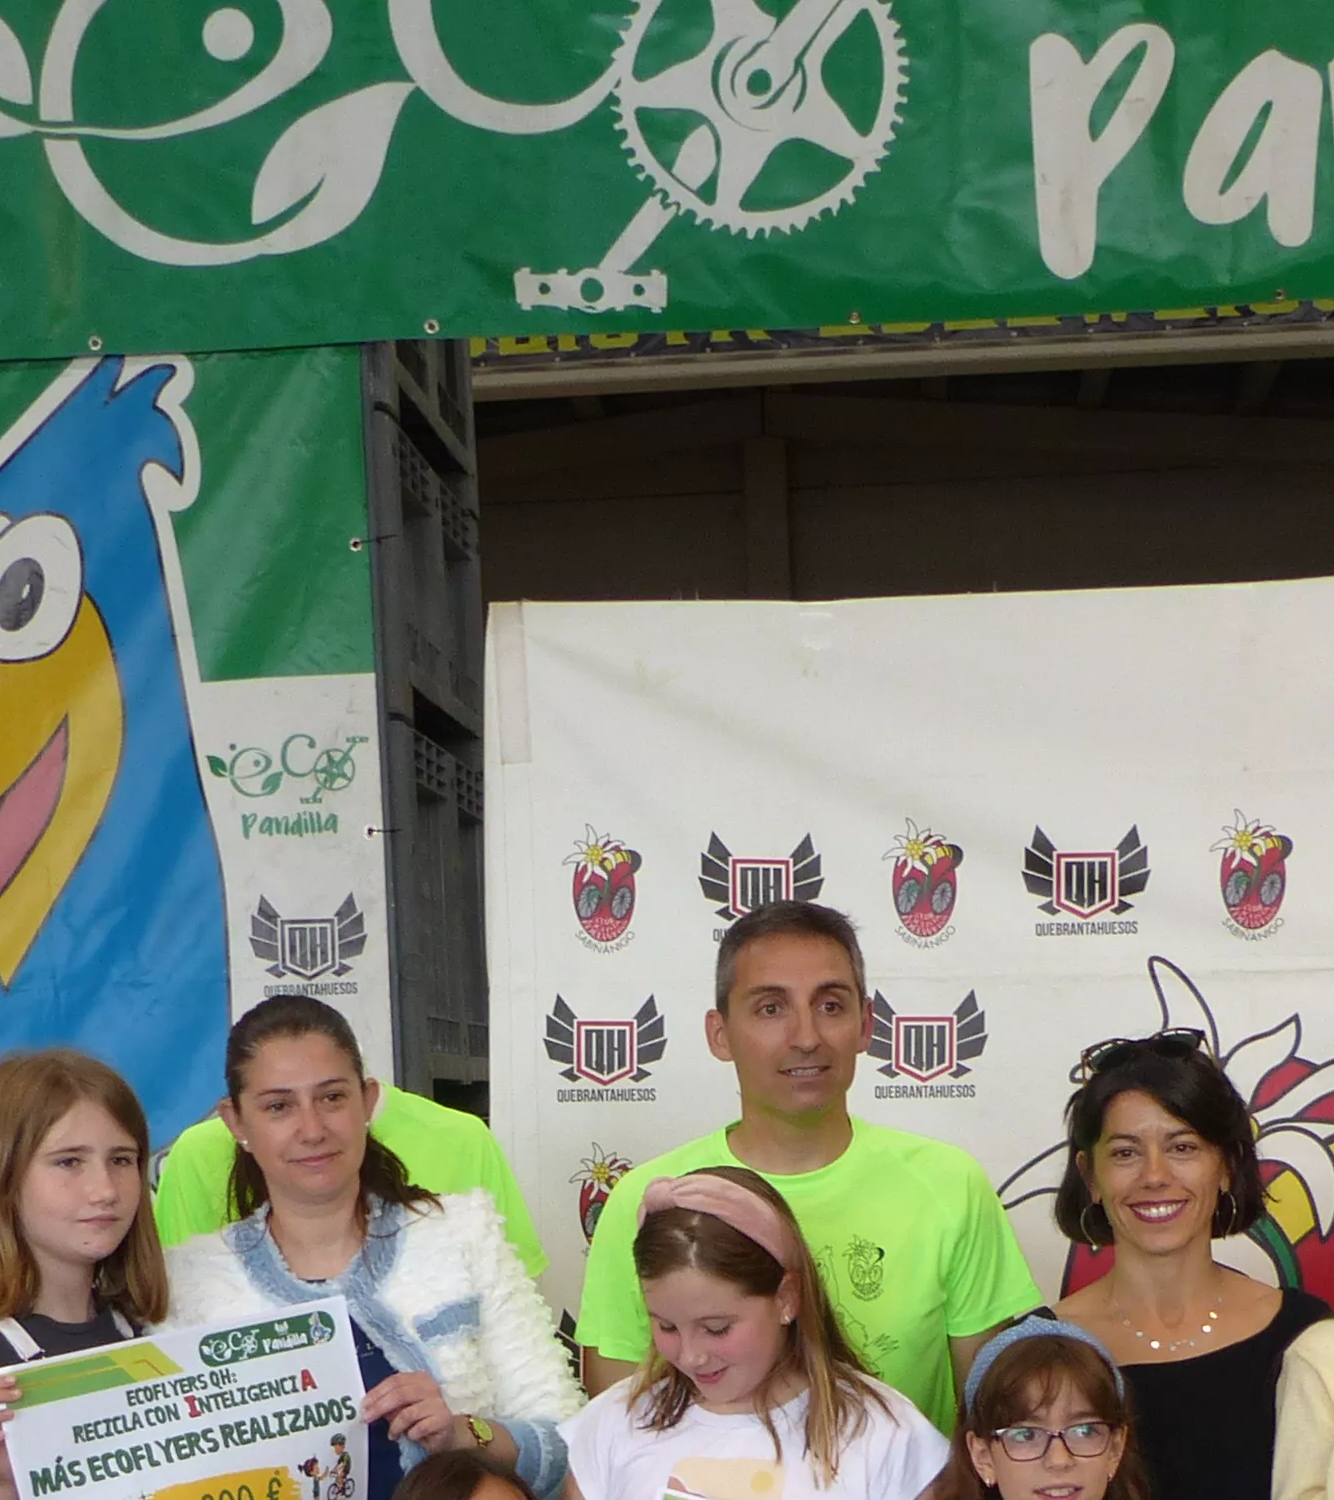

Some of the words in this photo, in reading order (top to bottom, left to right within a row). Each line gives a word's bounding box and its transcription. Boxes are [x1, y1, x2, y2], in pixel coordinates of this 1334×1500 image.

[241, 811, 339, 840] Pandilla
[1034, 919, 1140, 938] QUEBRANTAHUESOS
[556, 1086, 657, 1104] QUEBRANTAHUESOS
[873, 1082, 977, 1101] QUEBRANTAHUESOS
[126, 1373, 208, 1408] ECOFLYERS
[208, 1368, 238, 1390] QH:
[72, 1411, 144, 1445] RECICLA
[144, 1403, 181, 1430] CON
[29, 1455, 86, 1499] MÁS
[89, 1427, 220, 1483] ECOFLYERS
[219, 1395, 357, 1449] REALIZADOS
